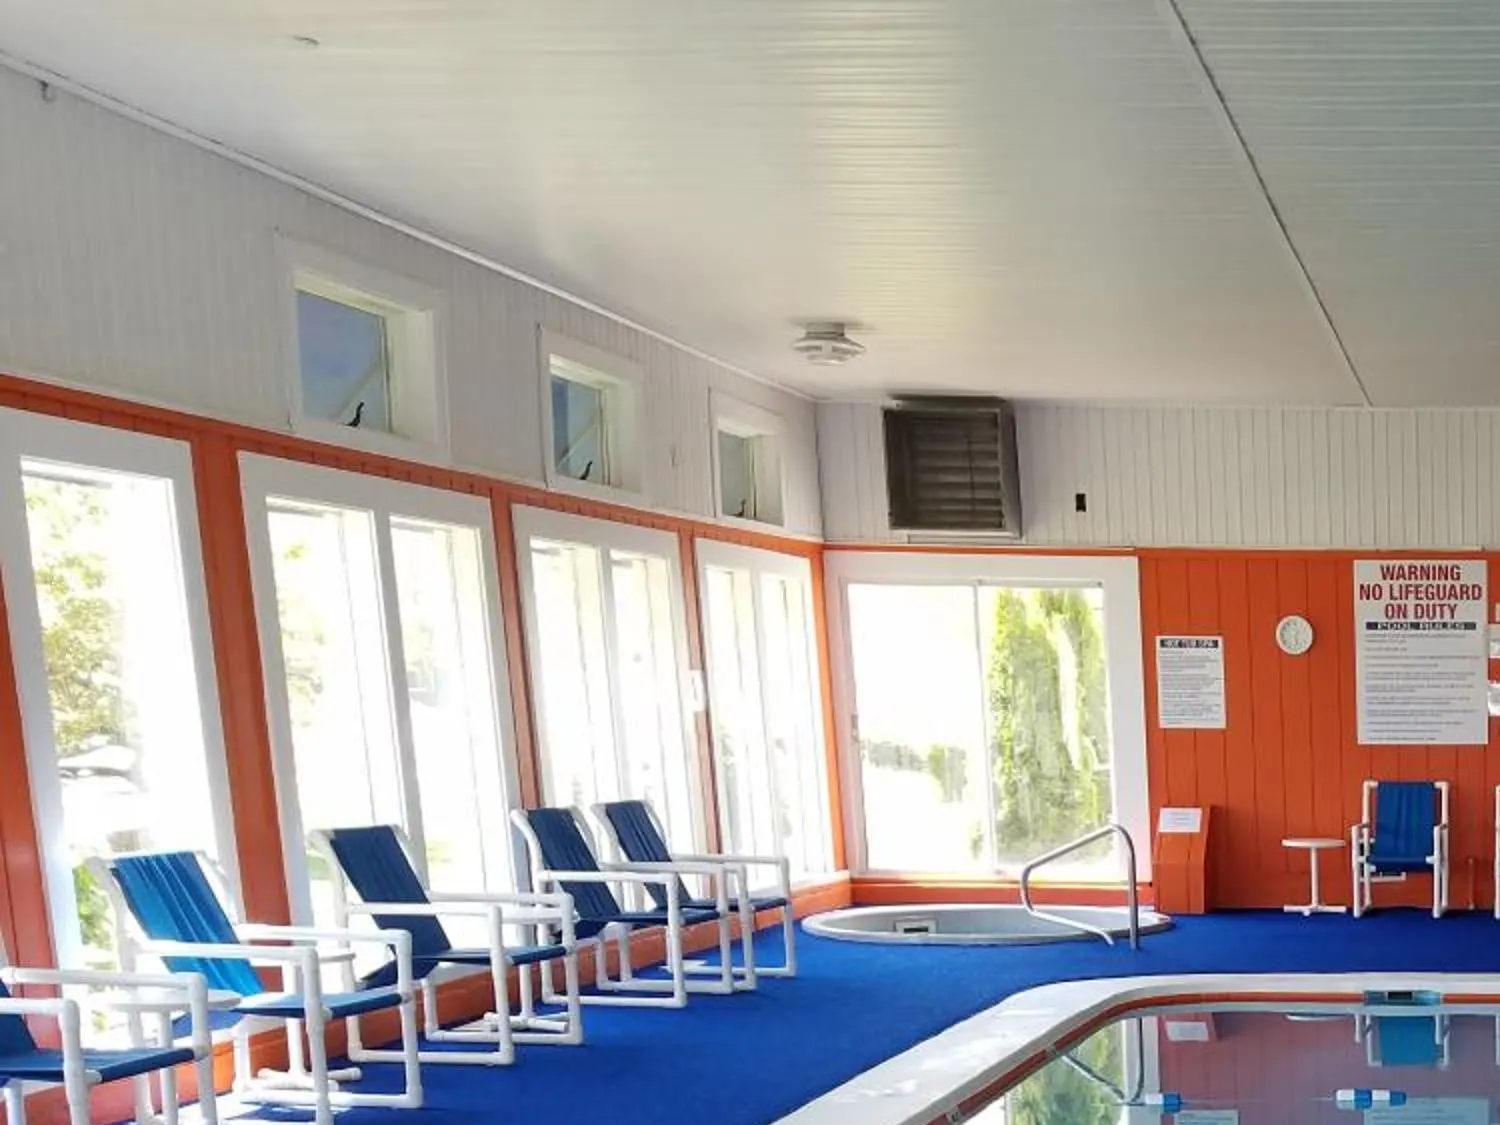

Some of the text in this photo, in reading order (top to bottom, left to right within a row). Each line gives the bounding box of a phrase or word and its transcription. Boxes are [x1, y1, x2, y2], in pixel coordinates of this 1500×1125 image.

[1380, 564, 1461, 581] WARNING
[1359, 584, 1482, 601] NO LIFEGUARD
[1384, 603, 1458, 620] ON DUTY
